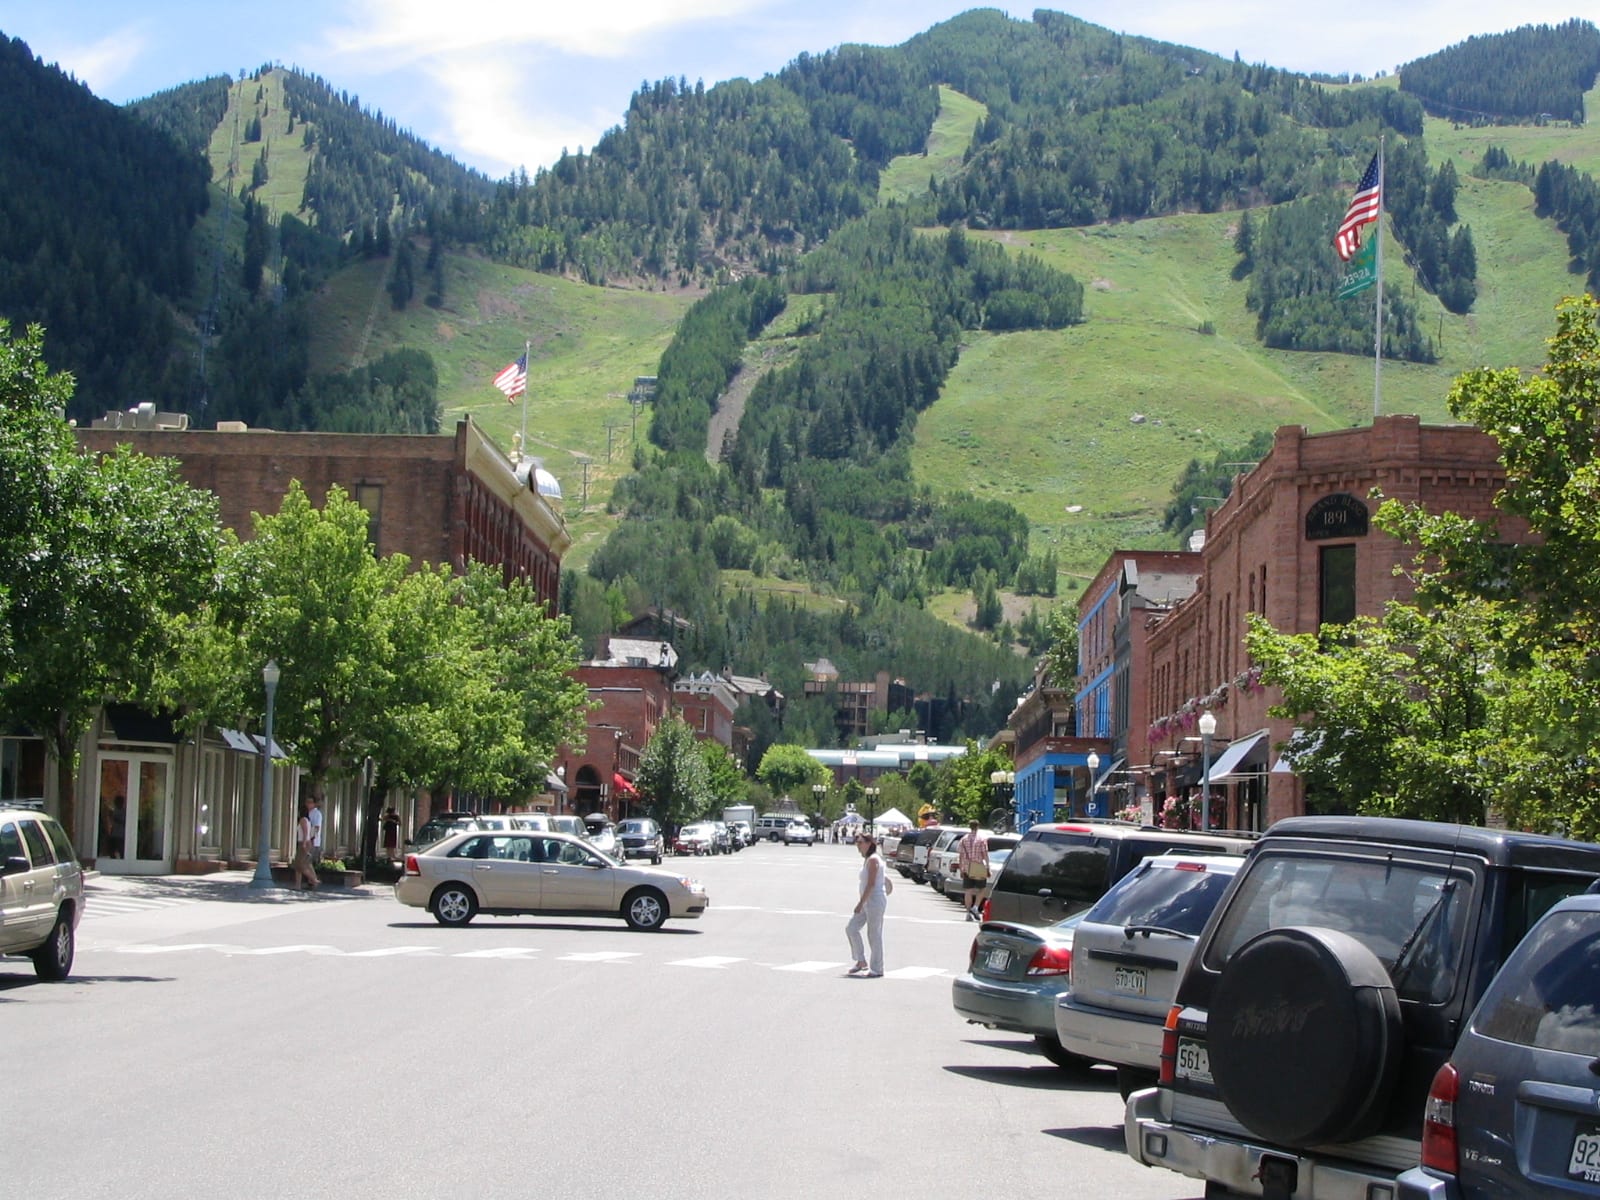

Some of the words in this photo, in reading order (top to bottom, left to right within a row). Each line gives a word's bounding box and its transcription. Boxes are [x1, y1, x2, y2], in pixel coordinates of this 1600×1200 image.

[1324, 510, 1346, 524] 1891
[1088, 802, 1097, 813] P
[1468, 1080, 1495, 1096] TOYOTA
[1465, 1149, 1479, 1160] V6
